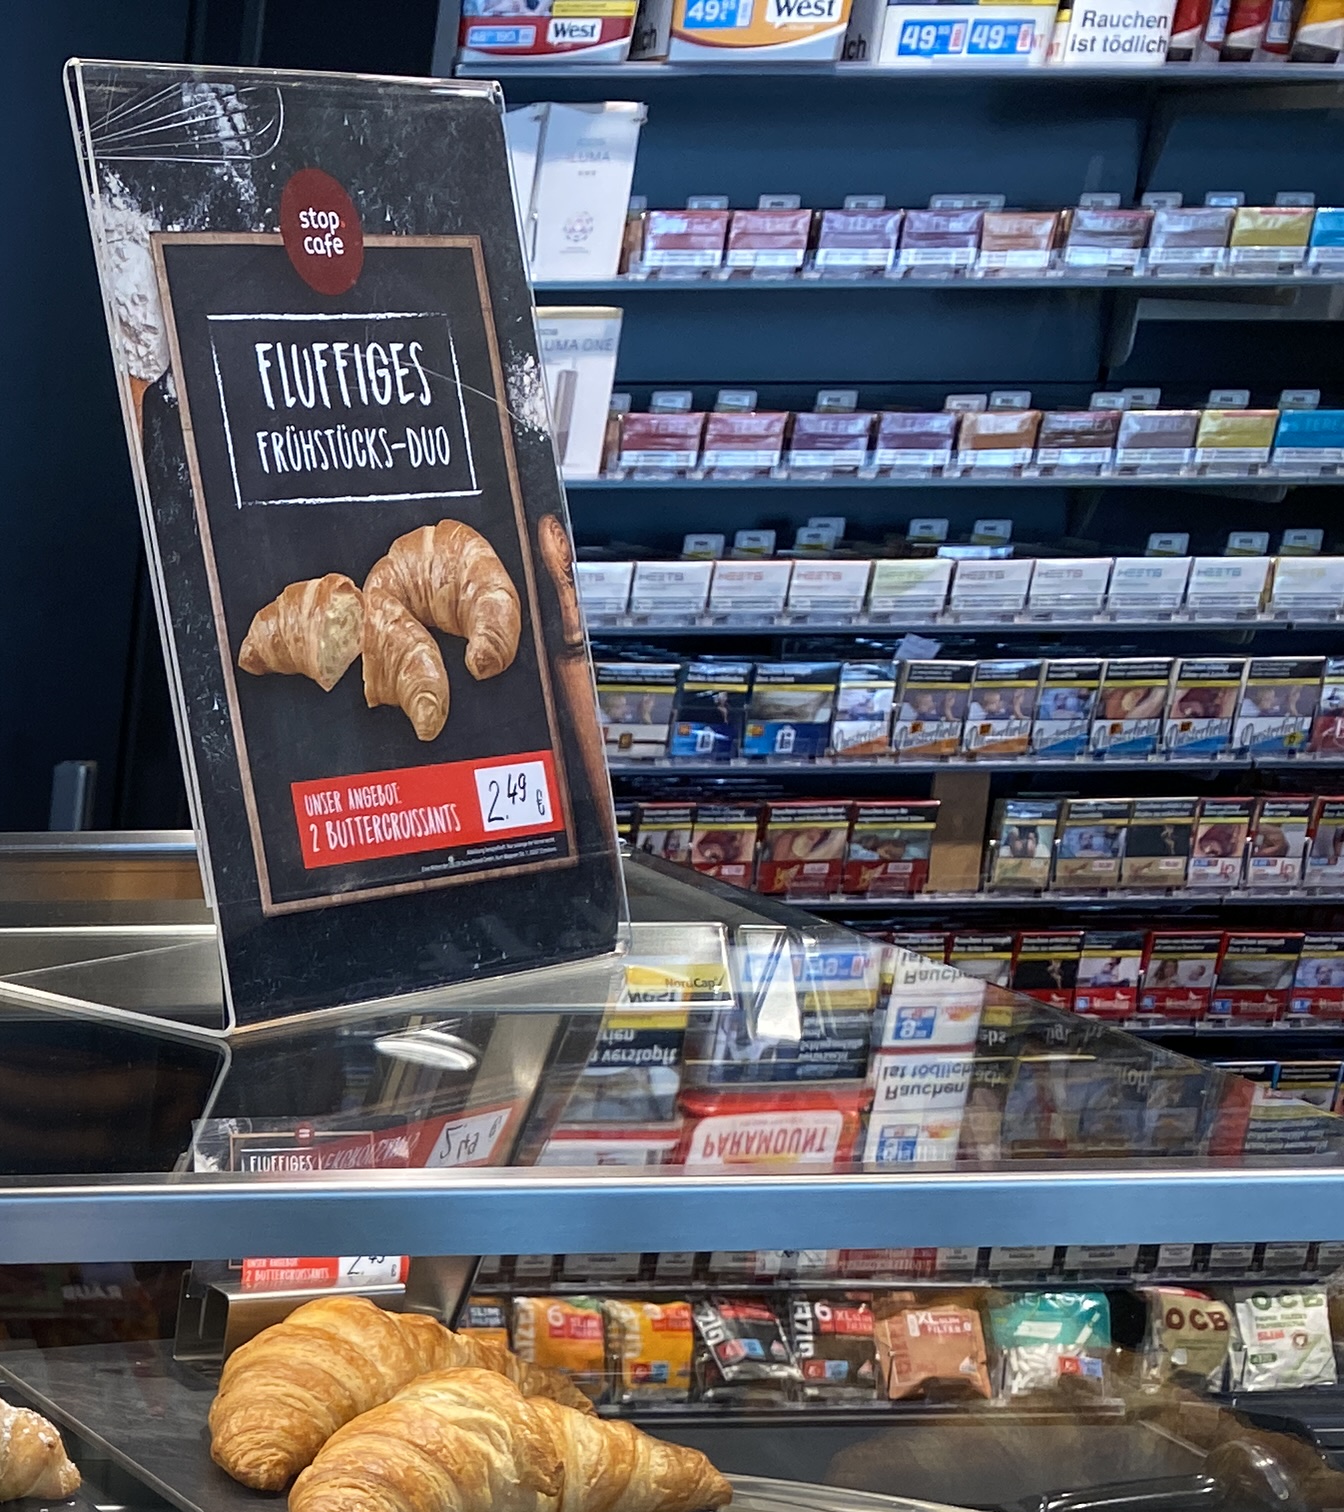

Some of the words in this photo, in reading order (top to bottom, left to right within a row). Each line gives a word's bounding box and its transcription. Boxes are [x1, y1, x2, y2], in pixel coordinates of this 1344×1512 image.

[553, 19, 597, 40] West
[1081, 10, 1168, 30] Rauchen
[1070, 34, 1098, 53] ist
[1102, 33, 1168, 55] tödlich
[304, 234, 345, 258] cafe
[255, 341, 432, 411] FLUFFIGES
[256, 423, 451, 474] FRÜHSTÜCKS-DUO
[304, 790, 343, 817] UNSER
[309, 823, 321, 853] 2
[325, 802, 462, 850] BUTTERCROISSANTS
[1165, 1306, 1228, 1332] OCB
